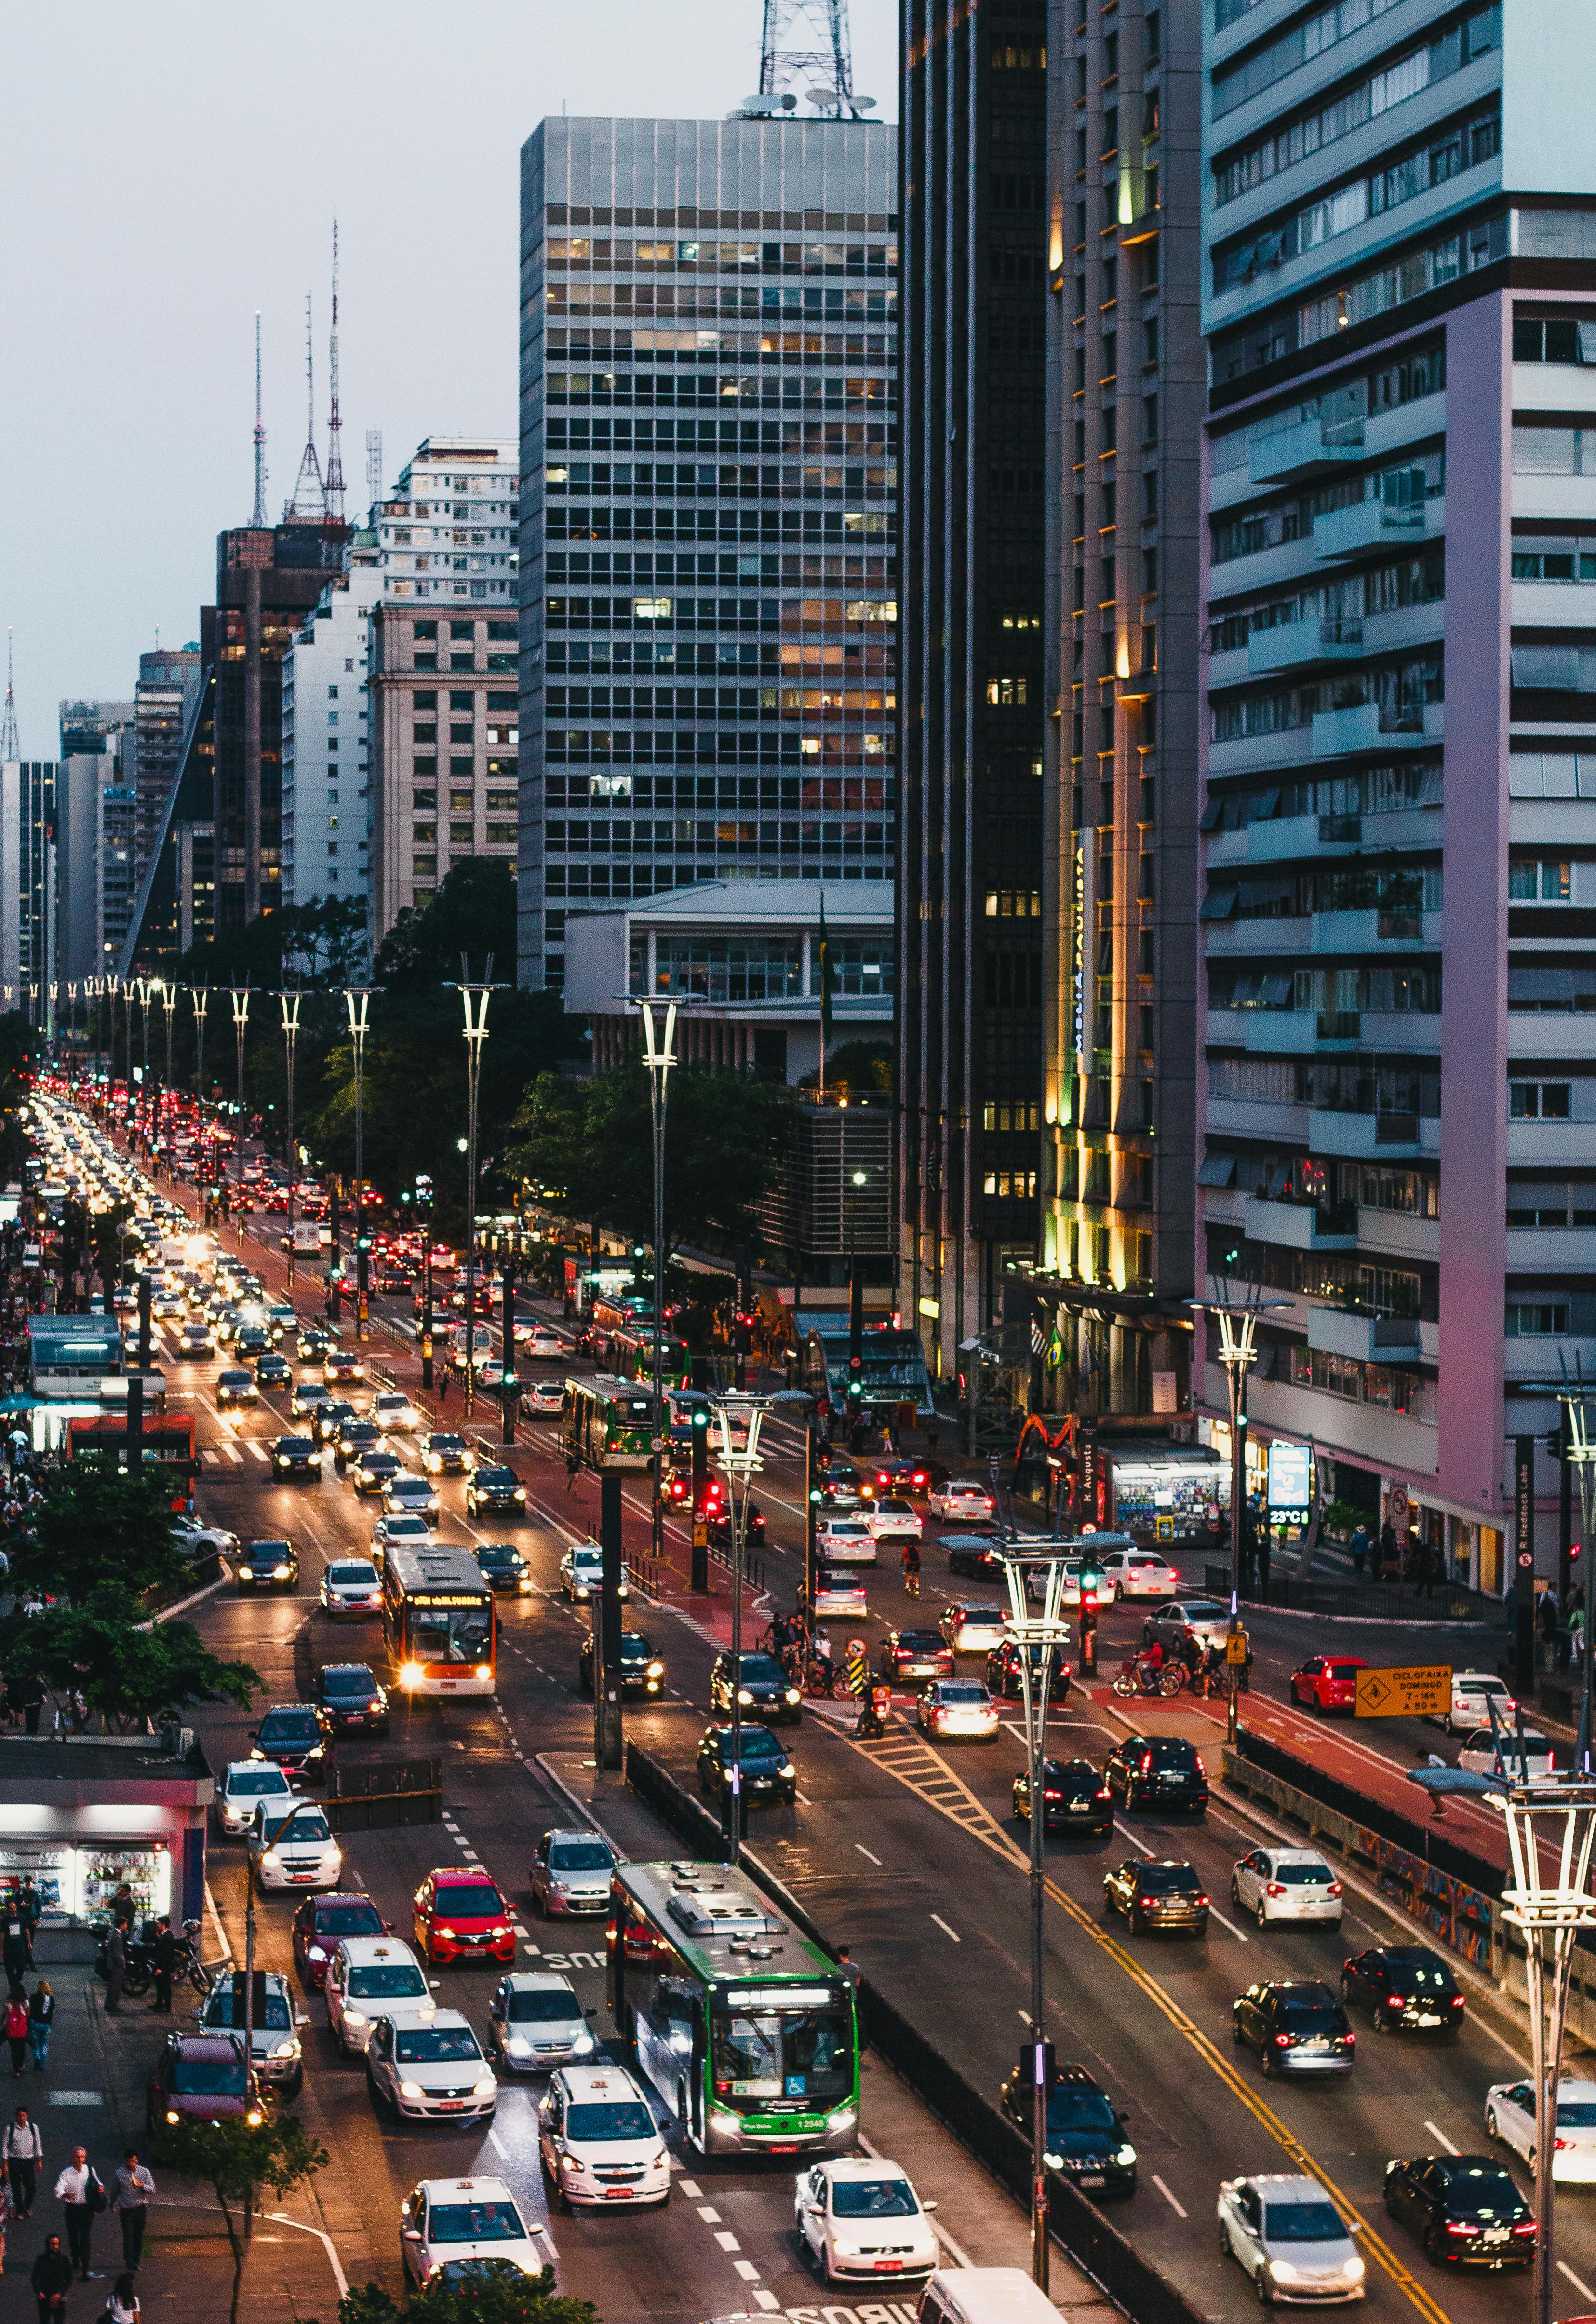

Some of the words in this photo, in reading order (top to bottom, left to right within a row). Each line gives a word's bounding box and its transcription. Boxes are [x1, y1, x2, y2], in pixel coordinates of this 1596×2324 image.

[1083, 1444, 1094, 1489] Augusta
[1270, 1511, 1301, 1528] 23°C
[1392, 1671, 1449, 1681] CICLOFAIXA
[1400, 1681, 1442, 1690] DOMINGO
[1404, 1702, 1410, 1710] A
